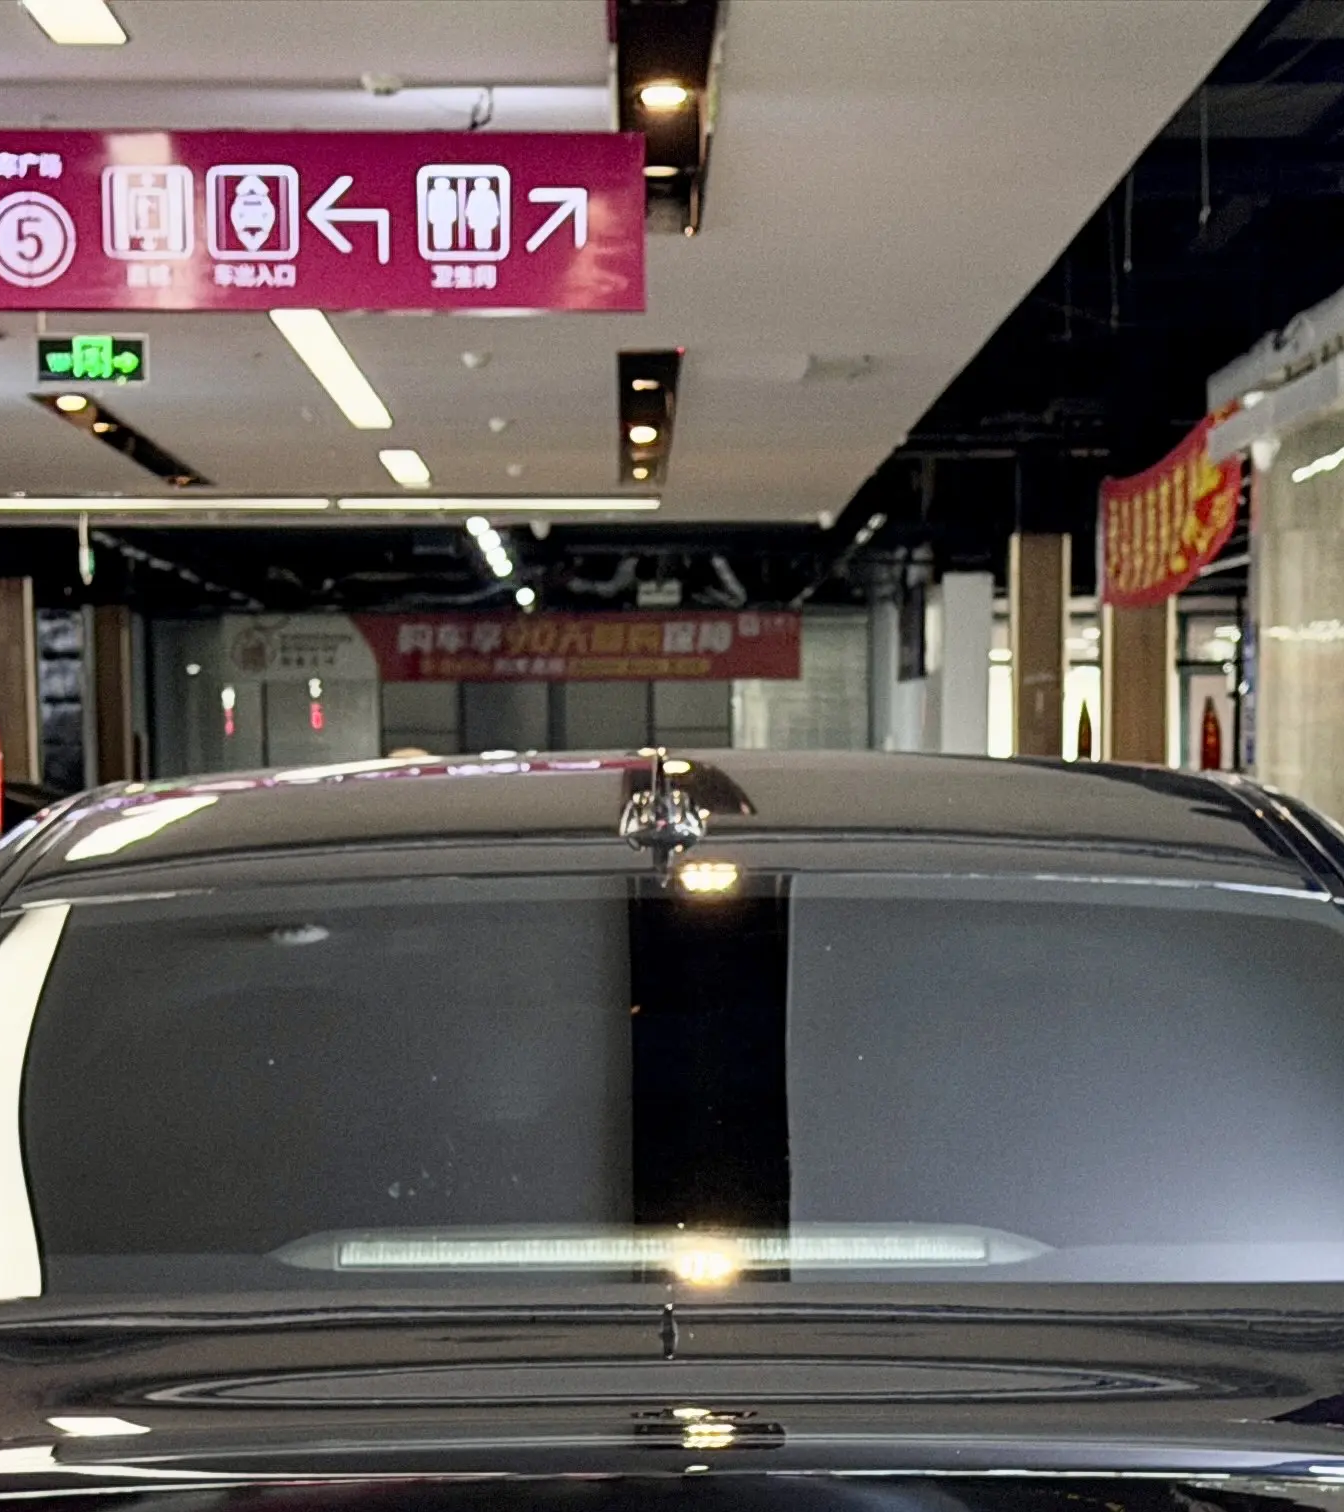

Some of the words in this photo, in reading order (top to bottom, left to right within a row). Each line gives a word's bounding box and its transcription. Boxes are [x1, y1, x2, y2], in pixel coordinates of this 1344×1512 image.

[15, 217, 43, 262] 5
[431, 265, 497, 289] 卫生间
